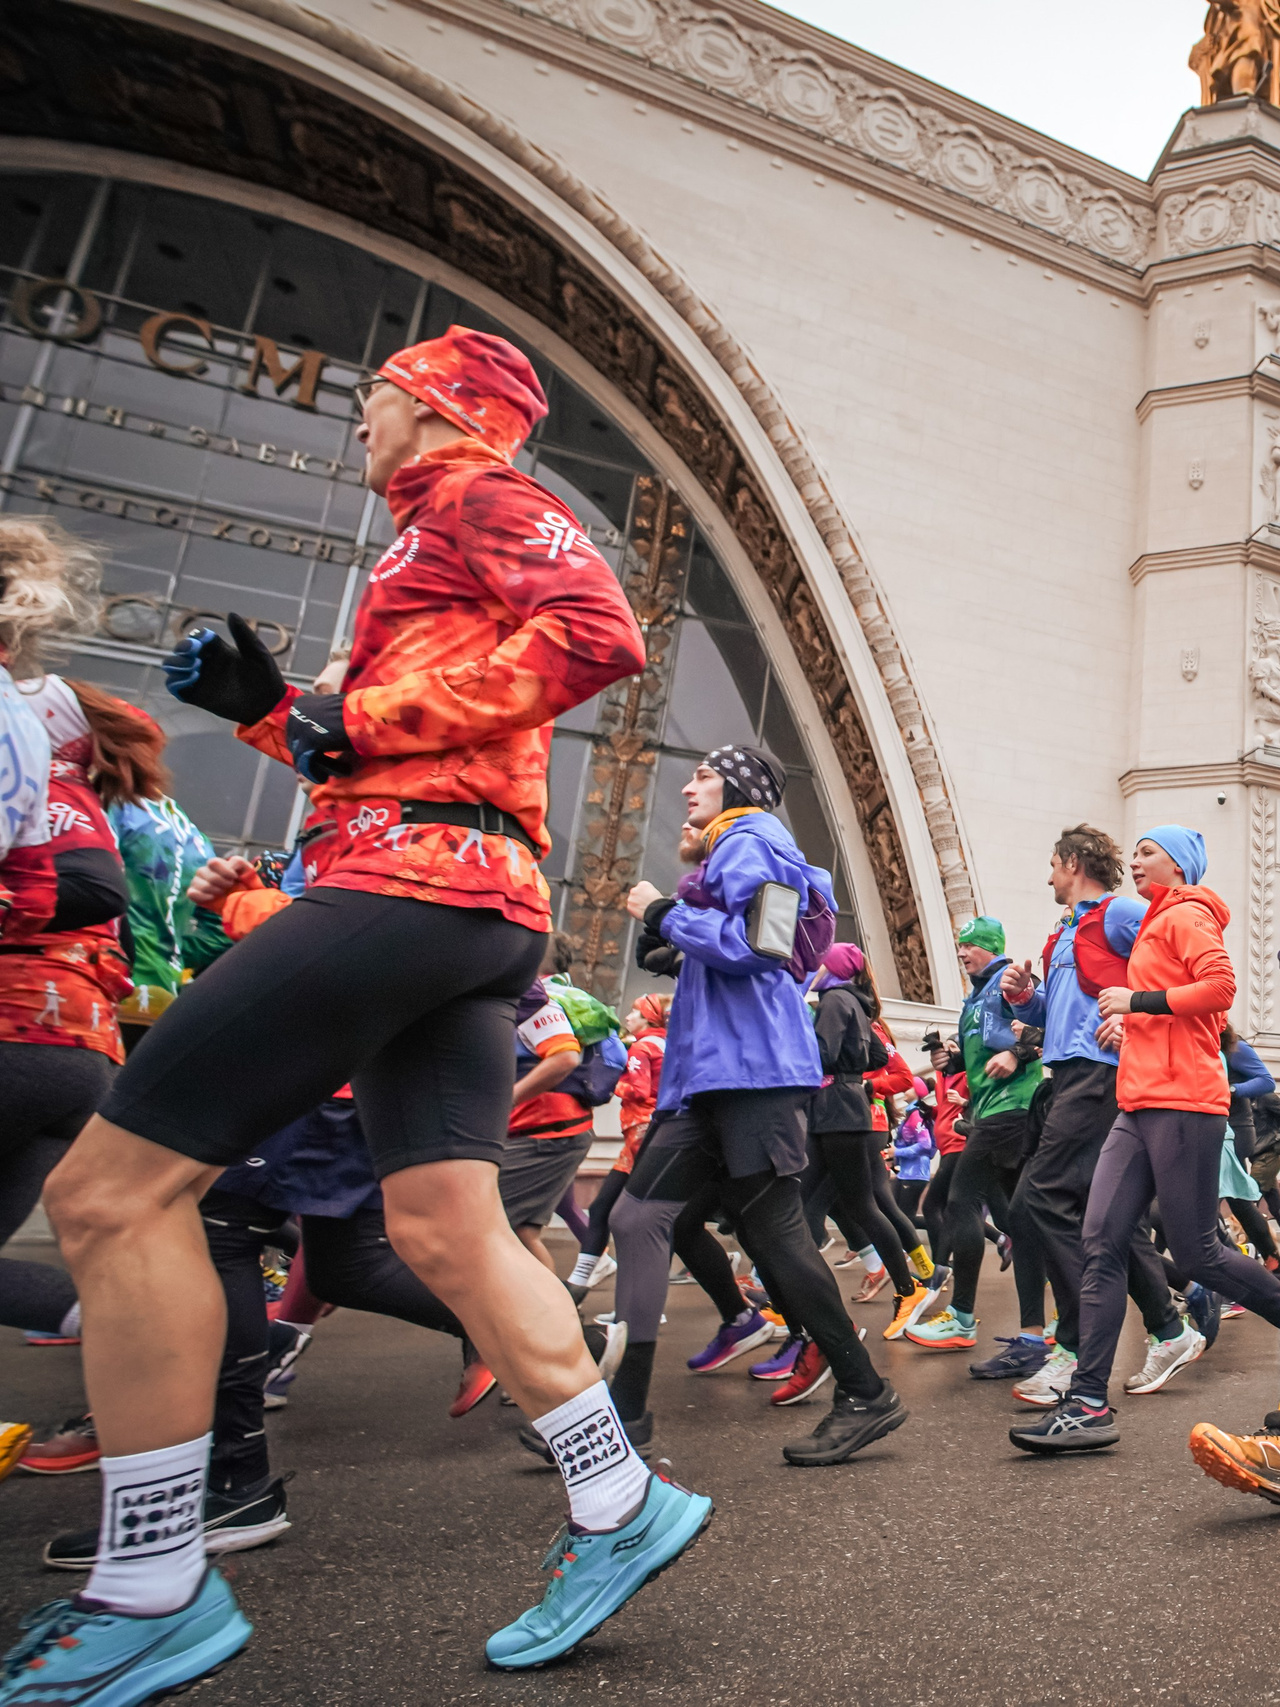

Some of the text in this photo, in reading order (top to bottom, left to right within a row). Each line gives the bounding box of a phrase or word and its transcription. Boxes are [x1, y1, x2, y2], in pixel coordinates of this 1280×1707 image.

[289, 705, 330, 735] ELITE
[556, 1414, 611, 1451] мара
[562, 1427, 615, 1463] фону
[568, 1441, 621, 1478] дома
